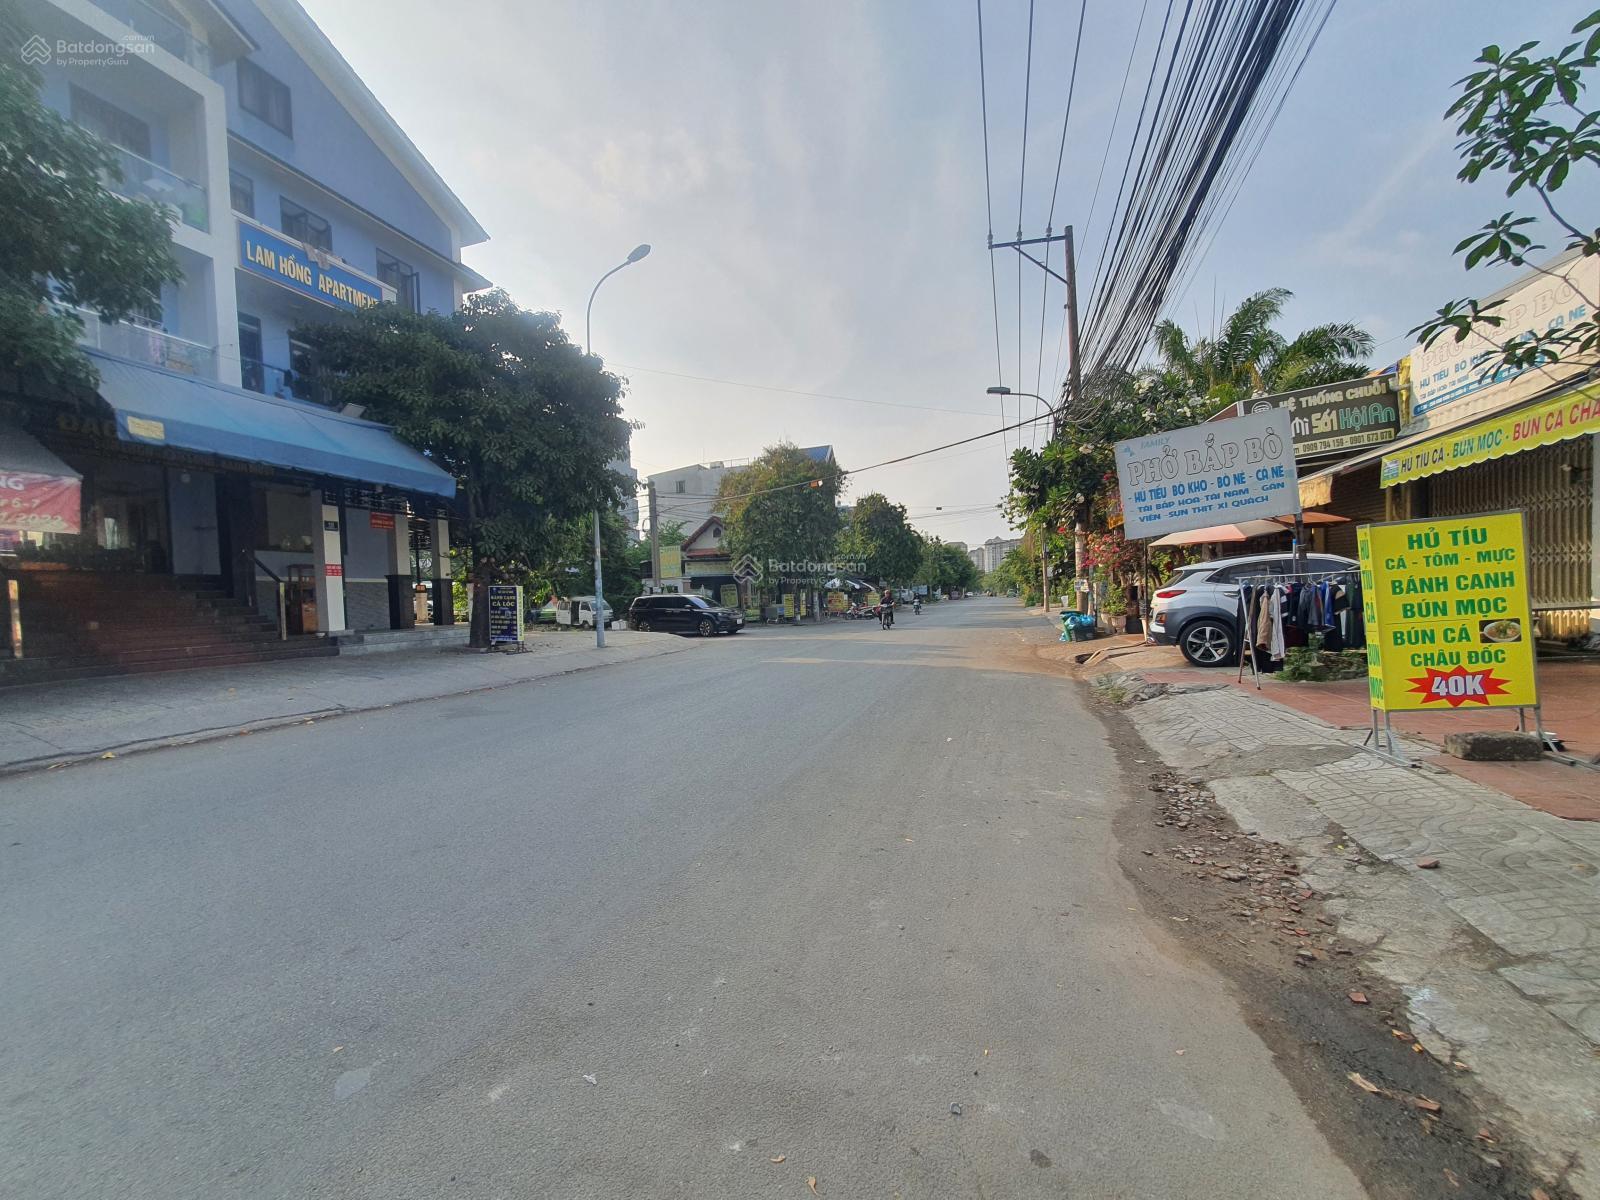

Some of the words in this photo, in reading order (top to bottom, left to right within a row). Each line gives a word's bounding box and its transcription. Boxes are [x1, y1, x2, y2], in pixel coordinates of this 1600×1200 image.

[246, 240, 276, 270] LAM
[279, 254, 312, 286] HỒNG
[1299, 389, 1344, 408] THỐNG
[1141, 435, 1171, 449] FAMILY
[1127, 445, 1179, 486] PHỞ
[1184, 432, 1239, 475] BẮP
[1244, 426, 1283, 464] BÒ
[1188, 479, 1208, 493] KHO
[1407, 527, 1440, 550] HỦ
[1448, 526, 1488, 546] TÍU
[1385, 553, 1407, 570] CÁ
[1423, 552, 1459, 568] TÔM
[1477, 548, 1516, 565] MỰC
[1391, 574, 1449, 595] BÁNH
[1456, 571, 1516, 591] CANH
[1402, 599, 1448, 619] BÚN
[1456, 597, 1508, 618] MỌC
[1393, 626, 1436, 646] BÚN
[1443, 623, 1472, 644] CÁ
[1410, 649, 1461, 667] CHÂU
[1467, 645, 1506, 665] ĐỐC
[1431, 674, 1485, 697] 40K
